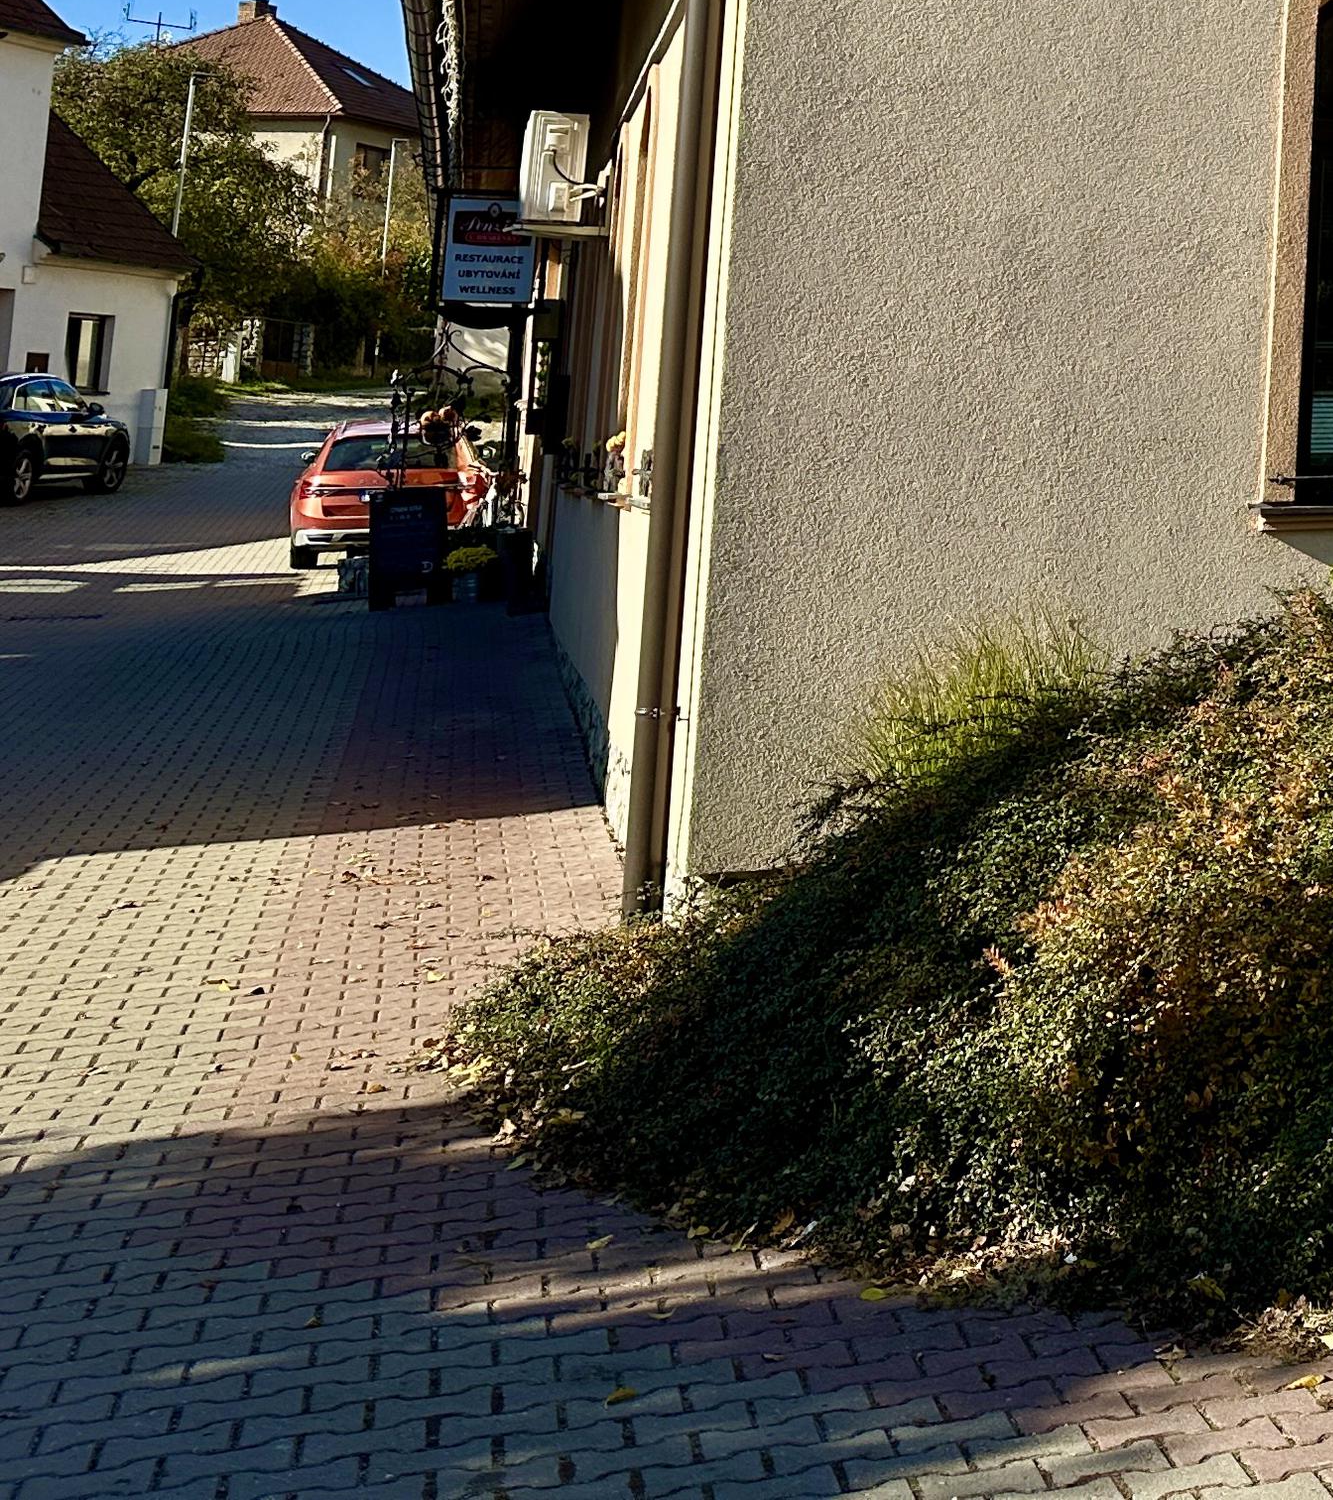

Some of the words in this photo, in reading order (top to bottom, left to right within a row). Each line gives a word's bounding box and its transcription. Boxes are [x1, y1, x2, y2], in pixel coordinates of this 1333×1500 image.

[455, 253, 524, 264] RESTAURACE
[458, 269, 520, 279] UBYTOVÁNÍ
[459, 285, 516, 295] WELLNESS
